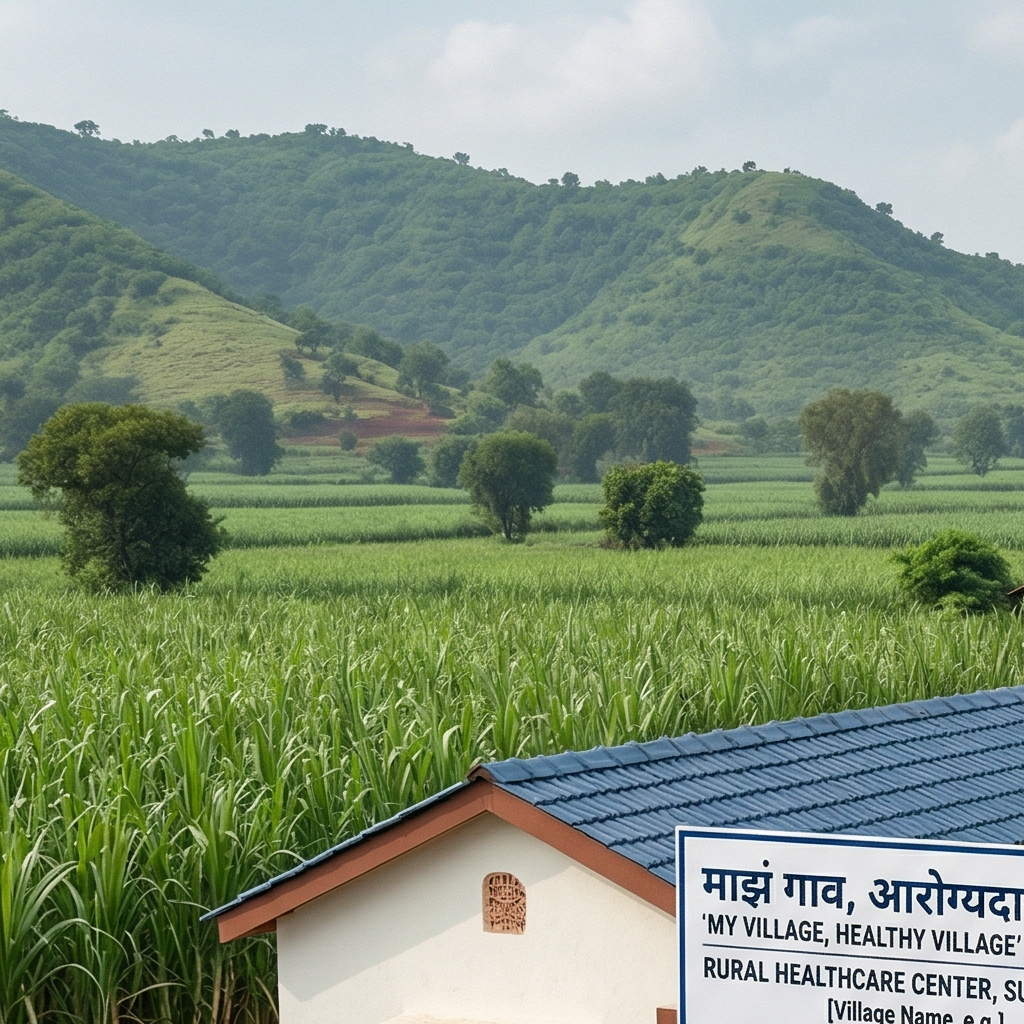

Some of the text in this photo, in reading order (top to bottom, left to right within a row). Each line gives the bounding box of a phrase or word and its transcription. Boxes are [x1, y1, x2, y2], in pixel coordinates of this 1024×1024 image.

[702, 859, 774, 908] माझं
[783, 874, 854, 915] गाव,
[743, 917, 828, 944] VILLAGE,
[837, 923, 925, 949] HEALTHY
[704, 957, 769, 982] RURAL
[776, 962, 905, 993] HEALTHCARE
[911, 972, 998, 1004] CENTER,
[828, 998, 895, 1024] [Village
